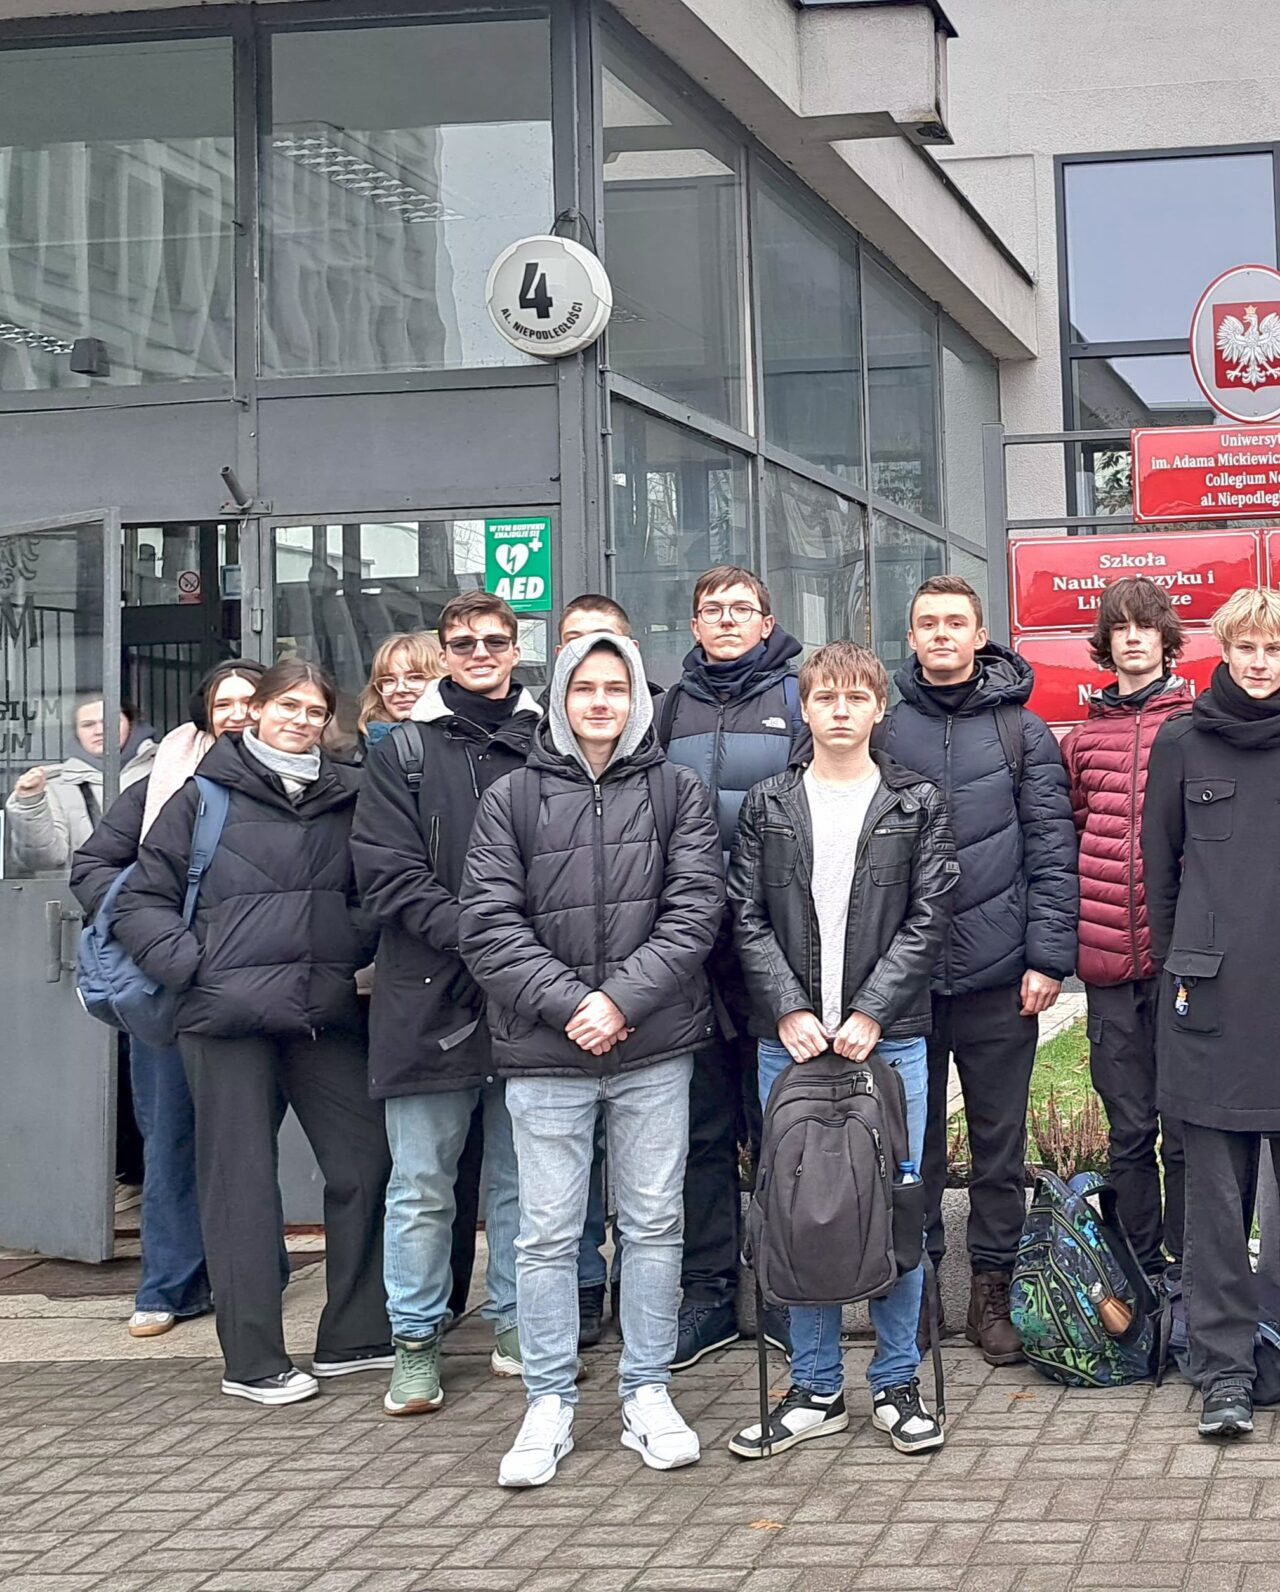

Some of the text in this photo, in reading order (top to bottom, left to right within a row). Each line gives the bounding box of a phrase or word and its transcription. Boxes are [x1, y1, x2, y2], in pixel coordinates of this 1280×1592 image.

[518, 262, 554, 319] 4
[500, 301, 584, 340] AL. NIEPODLEGŁOŚCI
[1151, 457, 1171, 470] im.
[1173, 455, 1215, 469] Adama
[1205, 472, 1267, 490] Collegium
[1200, 494, 1216, 507] al.
[1099, 552, 1167, 569] Szkoła
[494, 576, 545, 600] AED
[1053, 575, 1107, 591] Nauk
[1208, 570, 1215, 585] i
